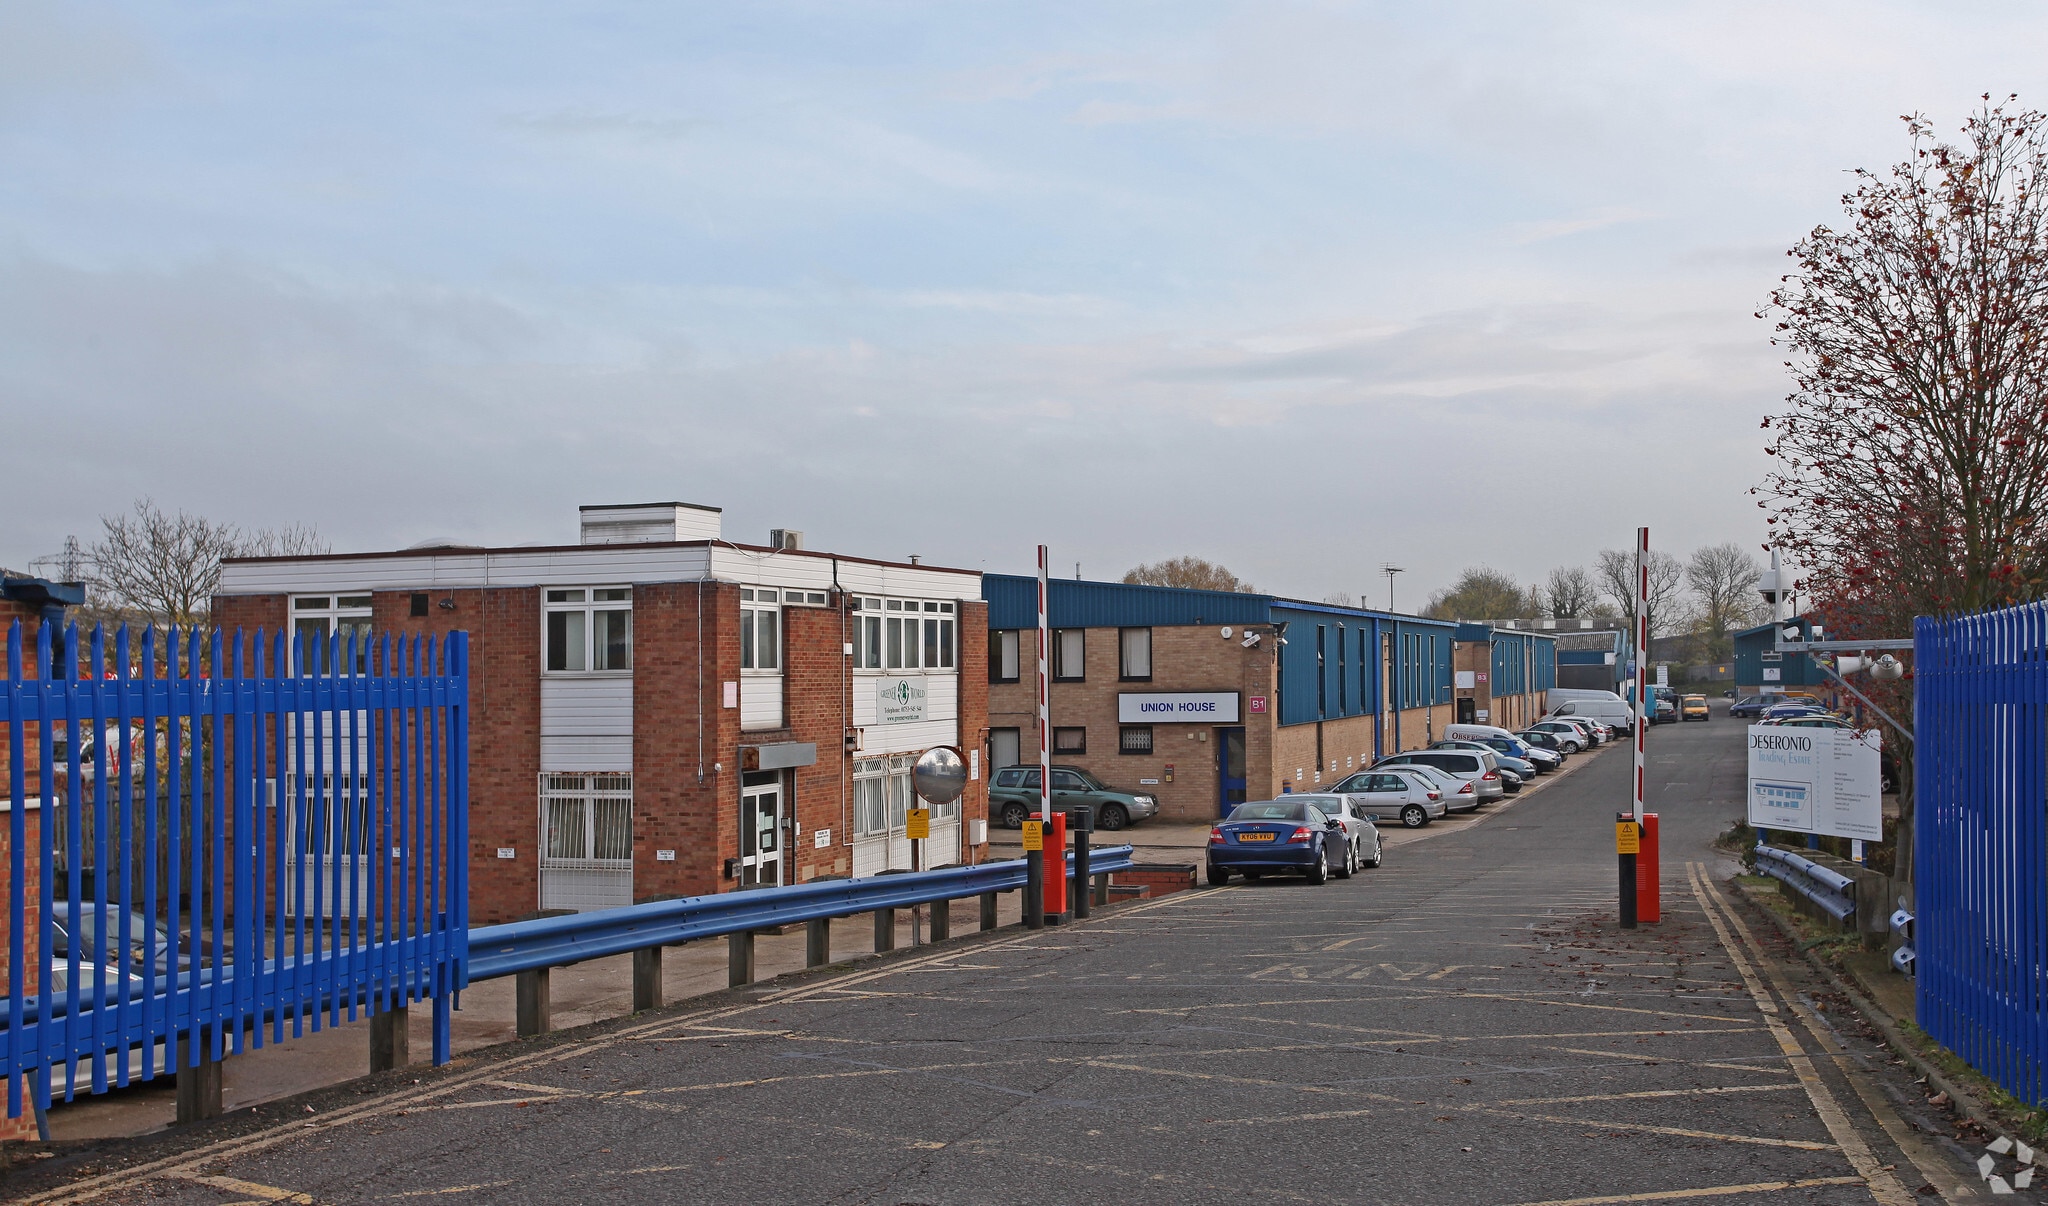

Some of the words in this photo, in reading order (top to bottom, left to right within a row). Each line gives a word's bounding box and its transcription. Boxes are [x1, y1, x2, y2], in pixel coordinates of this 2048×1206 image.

[910, 686, 926, 700] WORLD
[1141, 702, 1174, 712] UNION
[1178, 702, 1216, 712] HOUSE
[1252, 700, 1264, 709] B1
[1750, 734, 1812, 752] DESERONTO
